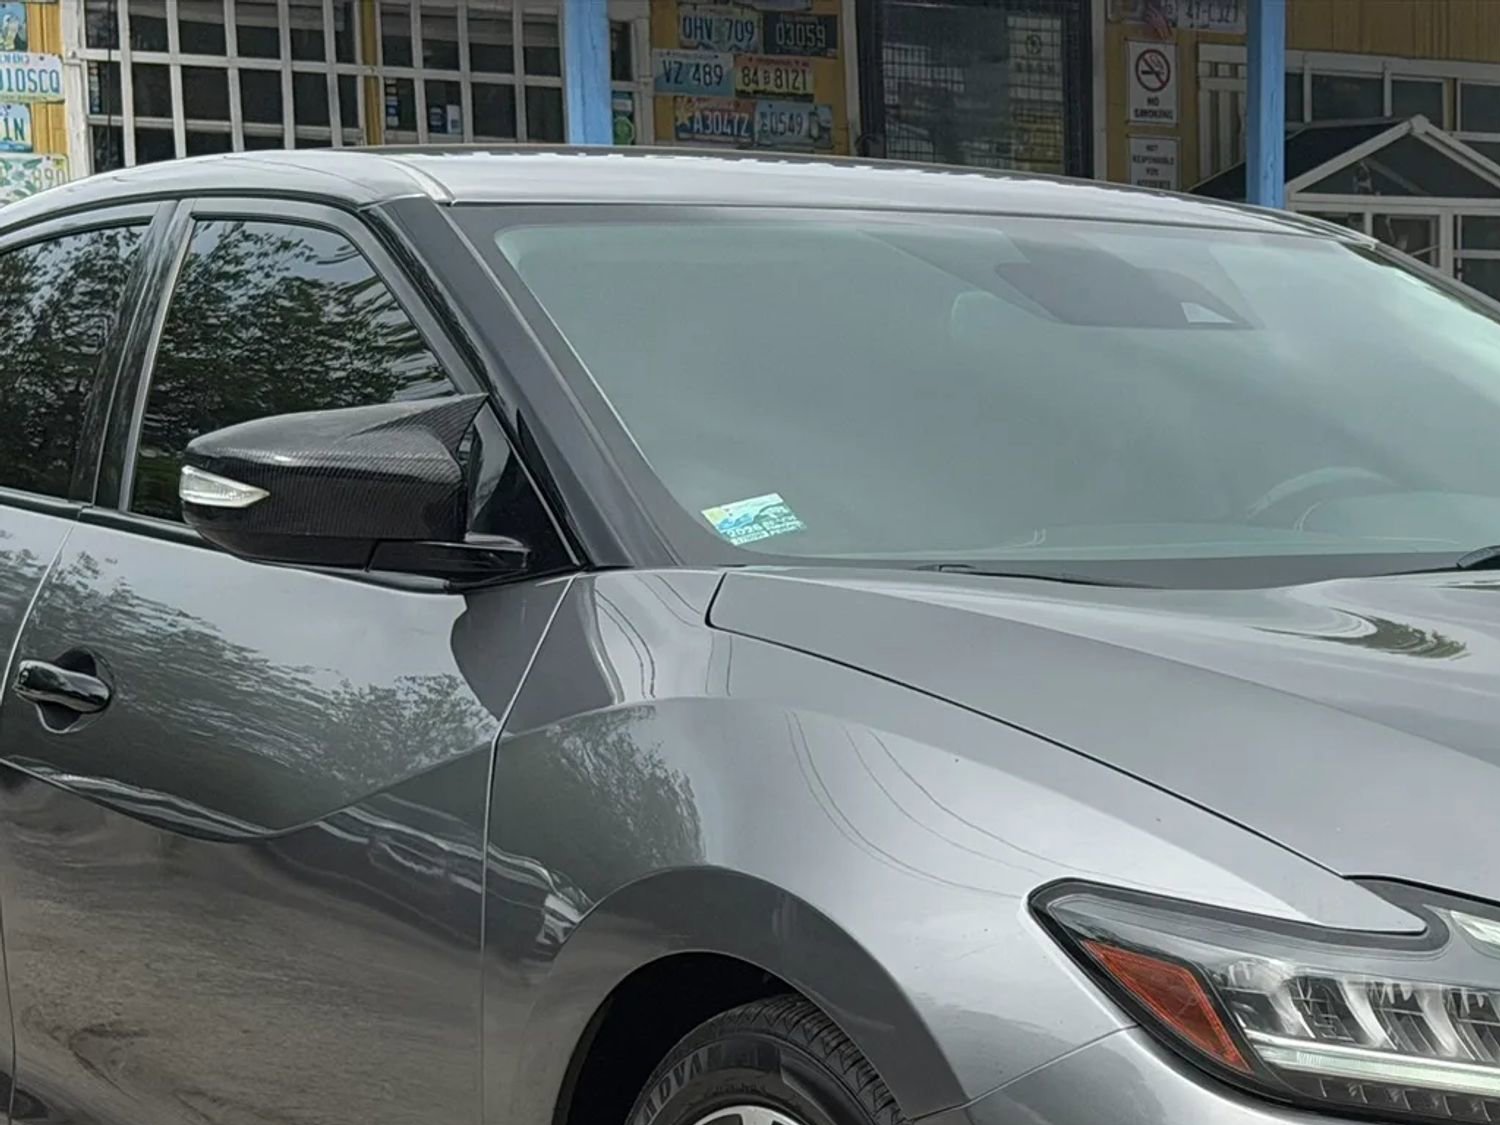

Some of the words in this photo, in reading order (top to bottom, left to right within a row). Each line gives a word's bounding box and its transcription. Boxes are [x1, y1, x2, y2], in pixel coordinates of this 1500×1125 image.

[726, 17, 755, 43] 709
[662, 59, 684, 85] VZ
[692, 62, 724, 87] 489
